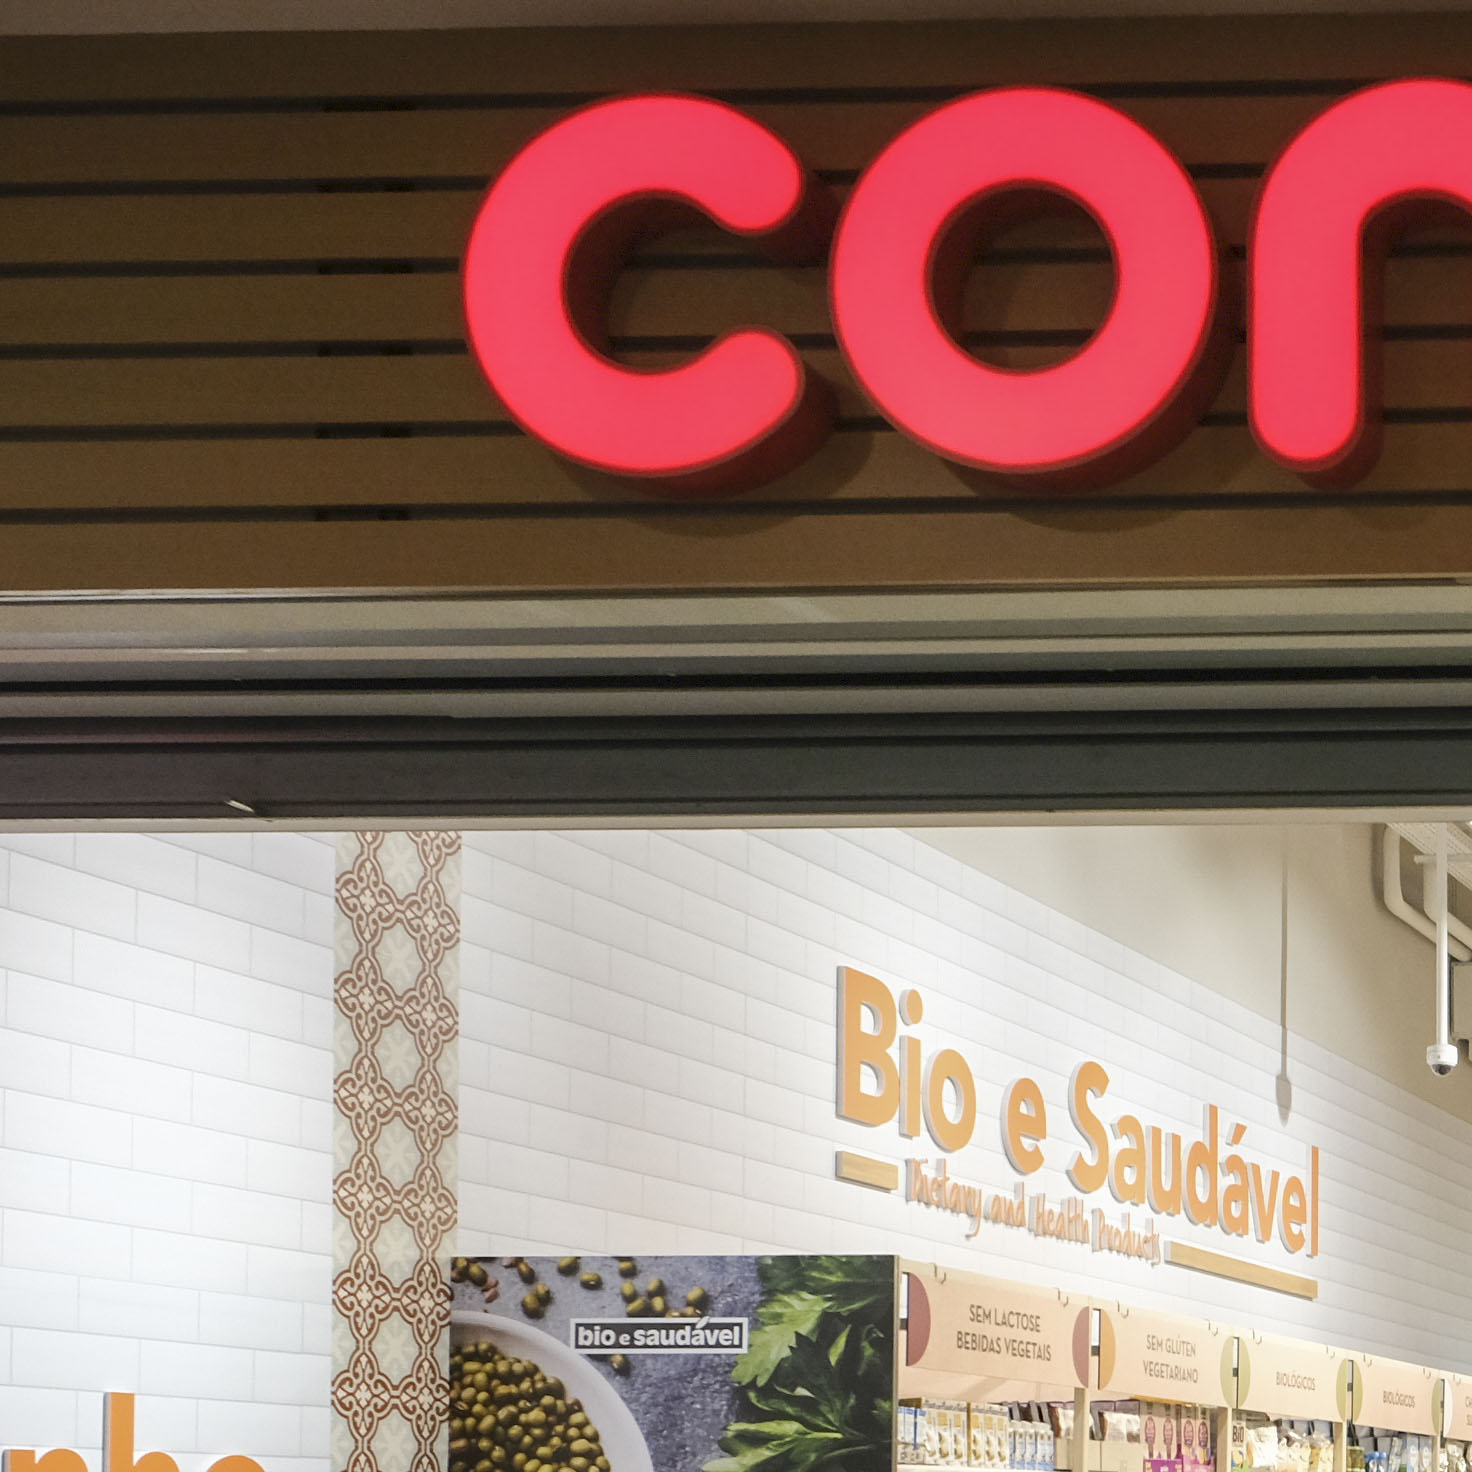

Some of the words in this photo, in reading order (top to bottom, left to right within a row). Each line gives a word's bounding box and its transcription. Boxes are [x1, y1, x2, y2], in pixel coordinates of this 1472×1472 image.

[836, 965, 977, 1154] Bio
[1000, 1078, 1047, 1176] e
[1066, 1060, 1320, 1259] Saudável
[905, 1157, 982, 1241] Dietary
[984, 1181, 1026, 1228] and
[1028, 1192, 1090, 1244] Health
[1090, 1207, 1162, 1268] Products
[576, 1326, 616, 1348] bio
[619, 1334, 632, 1348] e
[633, 1318, 743, 1348] saudável
[969, 1303, 992, 1326] SEM
[994, 1309, 1041, 1334] LACTOSE
[956, 1330, 1002, 1355] BEBIDAS
[1003, 1338, 1052, 1363] VEGETAIS
[1146, 1333, 1163, 1352] SEM
[1165, 1335, 1196, 1358] GLÚTEN
[1143, 1359, 1199, 1384] VEGETARIANO
[1276, 1371, 1316, 1391] BIOLÓGICOS
